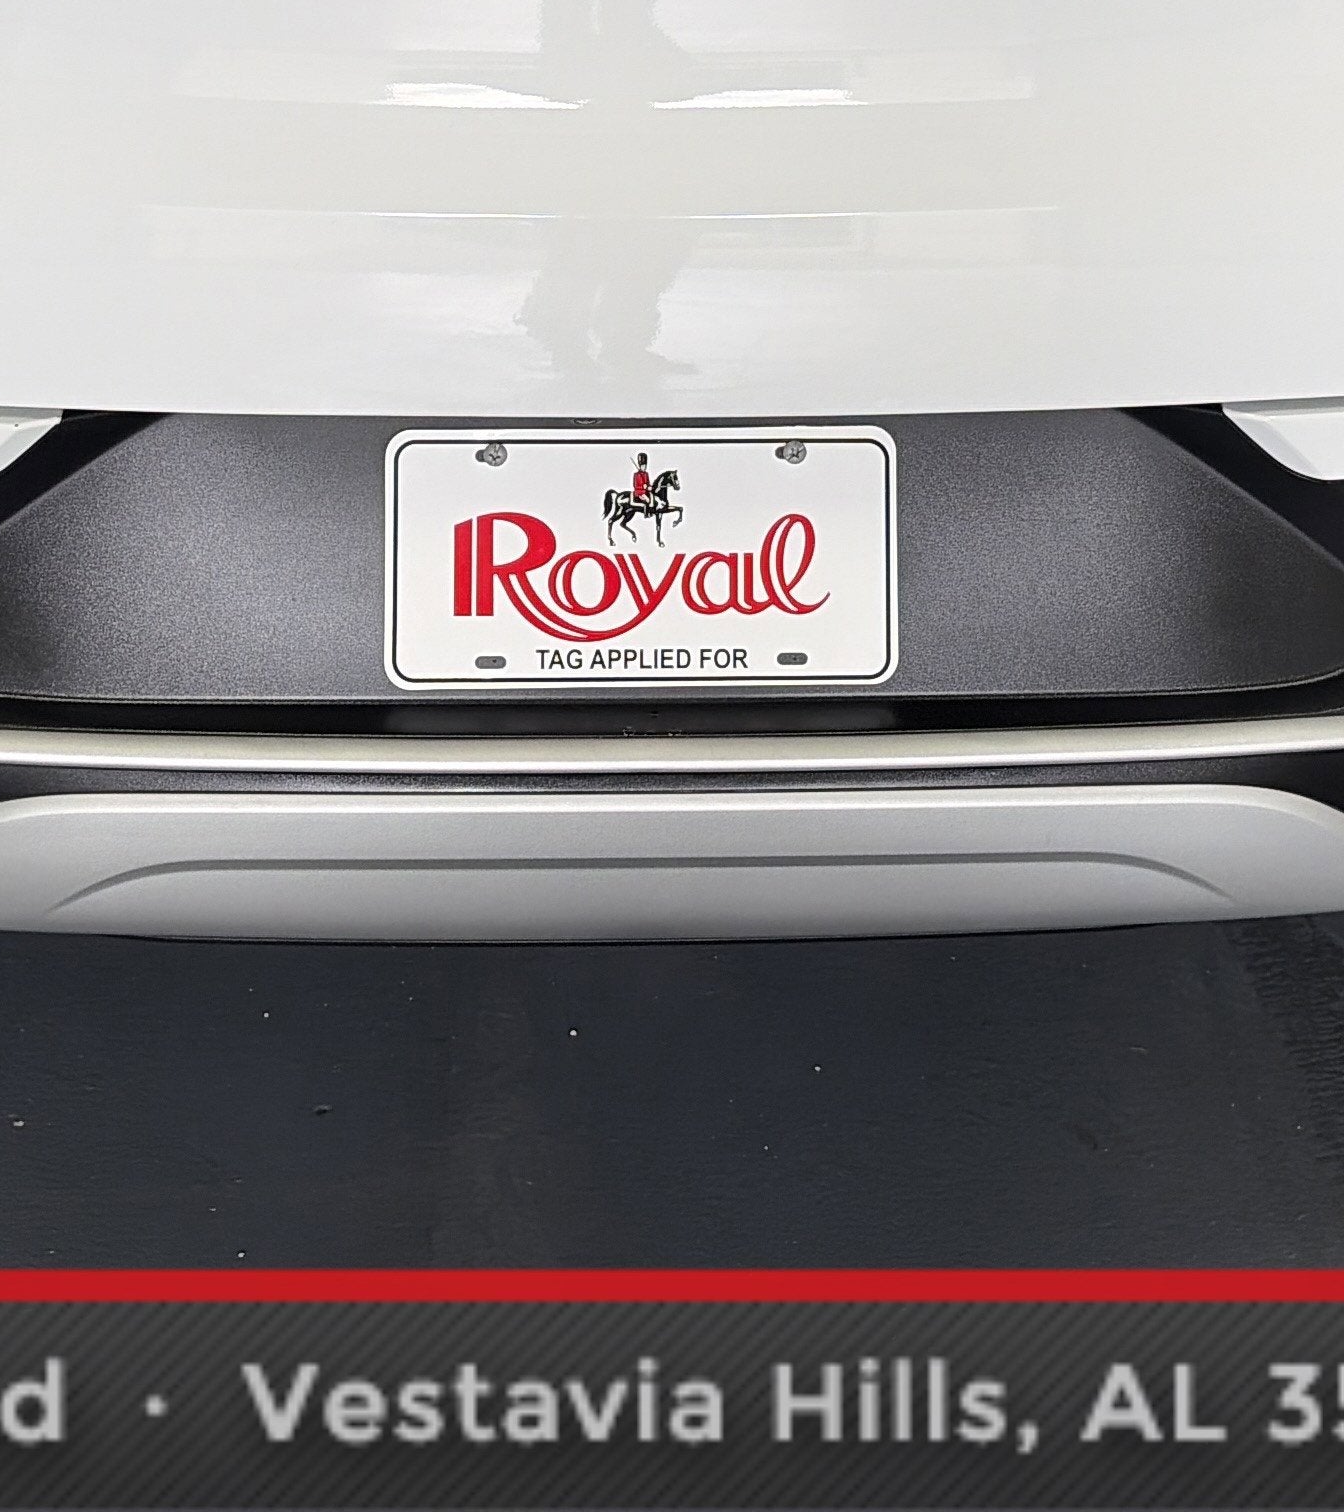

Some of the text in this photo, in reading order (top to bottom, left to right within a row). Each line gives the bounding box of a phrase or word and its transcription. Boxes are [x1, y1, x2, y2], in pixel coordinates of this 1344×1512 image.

[453, 510, 831, 643] Royal
[535, 647, 749, 670] TAG APPLIED FOR
